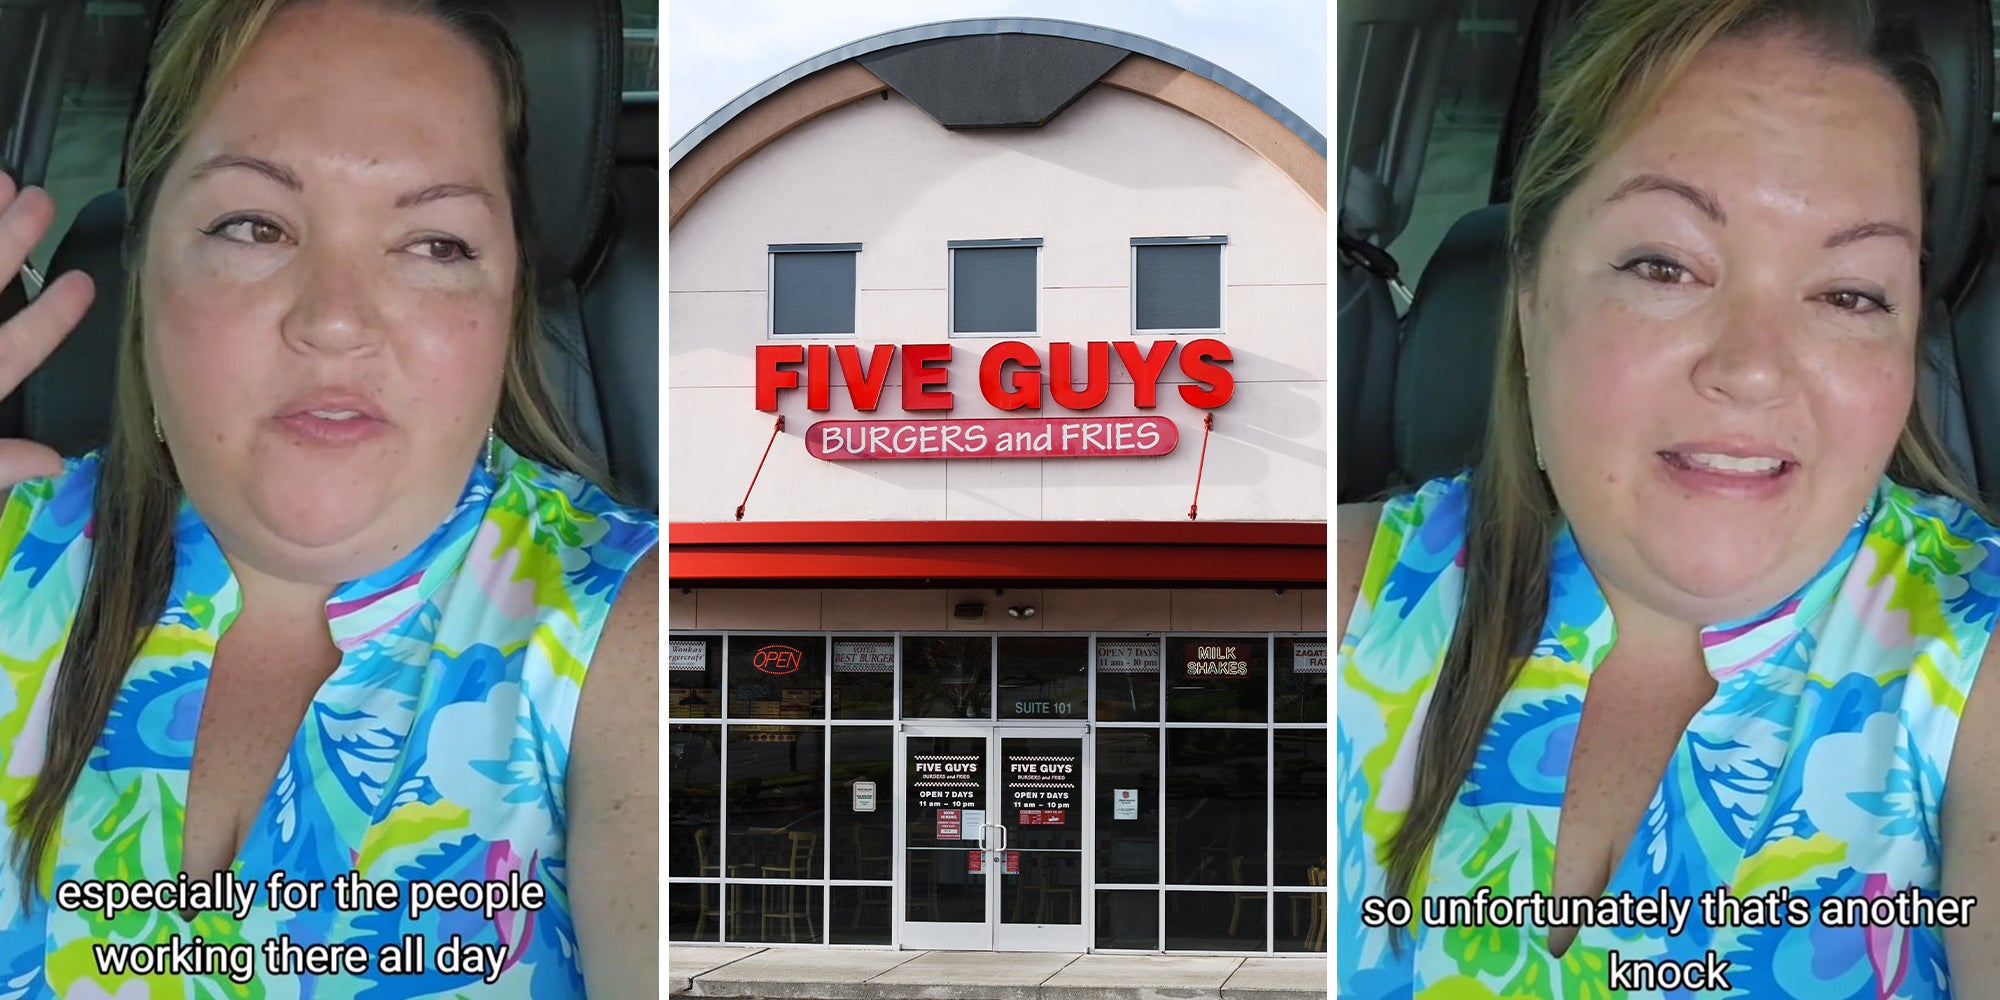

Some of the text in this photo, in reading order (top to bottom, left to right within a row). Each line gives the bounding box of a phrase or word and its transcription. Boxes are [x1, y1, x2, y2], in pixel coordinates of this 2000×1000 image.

[755, 340, 1235, 411] FIVE GUYS
[821, 421, 1161, 455] BURGERS and FRIES
[852, 646, 876, 654] VOTED
[1098, 647, 1159, 657] OPEN 7 DAYS
[1198, 646, 1237, 660] MILK
[752, 651, 802, 669] OPEN
[834, 653, 857, 663] BEST
[1100, 658, 1108, 666] 11
[1133, 658, 1141, 666] 10
[1144, 660, 1157, 668] pm
[1187, 661, 1248, 675] SHAKES
[1015, 701, 1072, 714] SUITE 101
[916, 763, 977, 773] FIVE GUYS
[1010, 764, 1073, 773] FIVE GUYS
[919, 790, 943, 798] OPEN
[1014, 791, 1038, 799] OPEN
